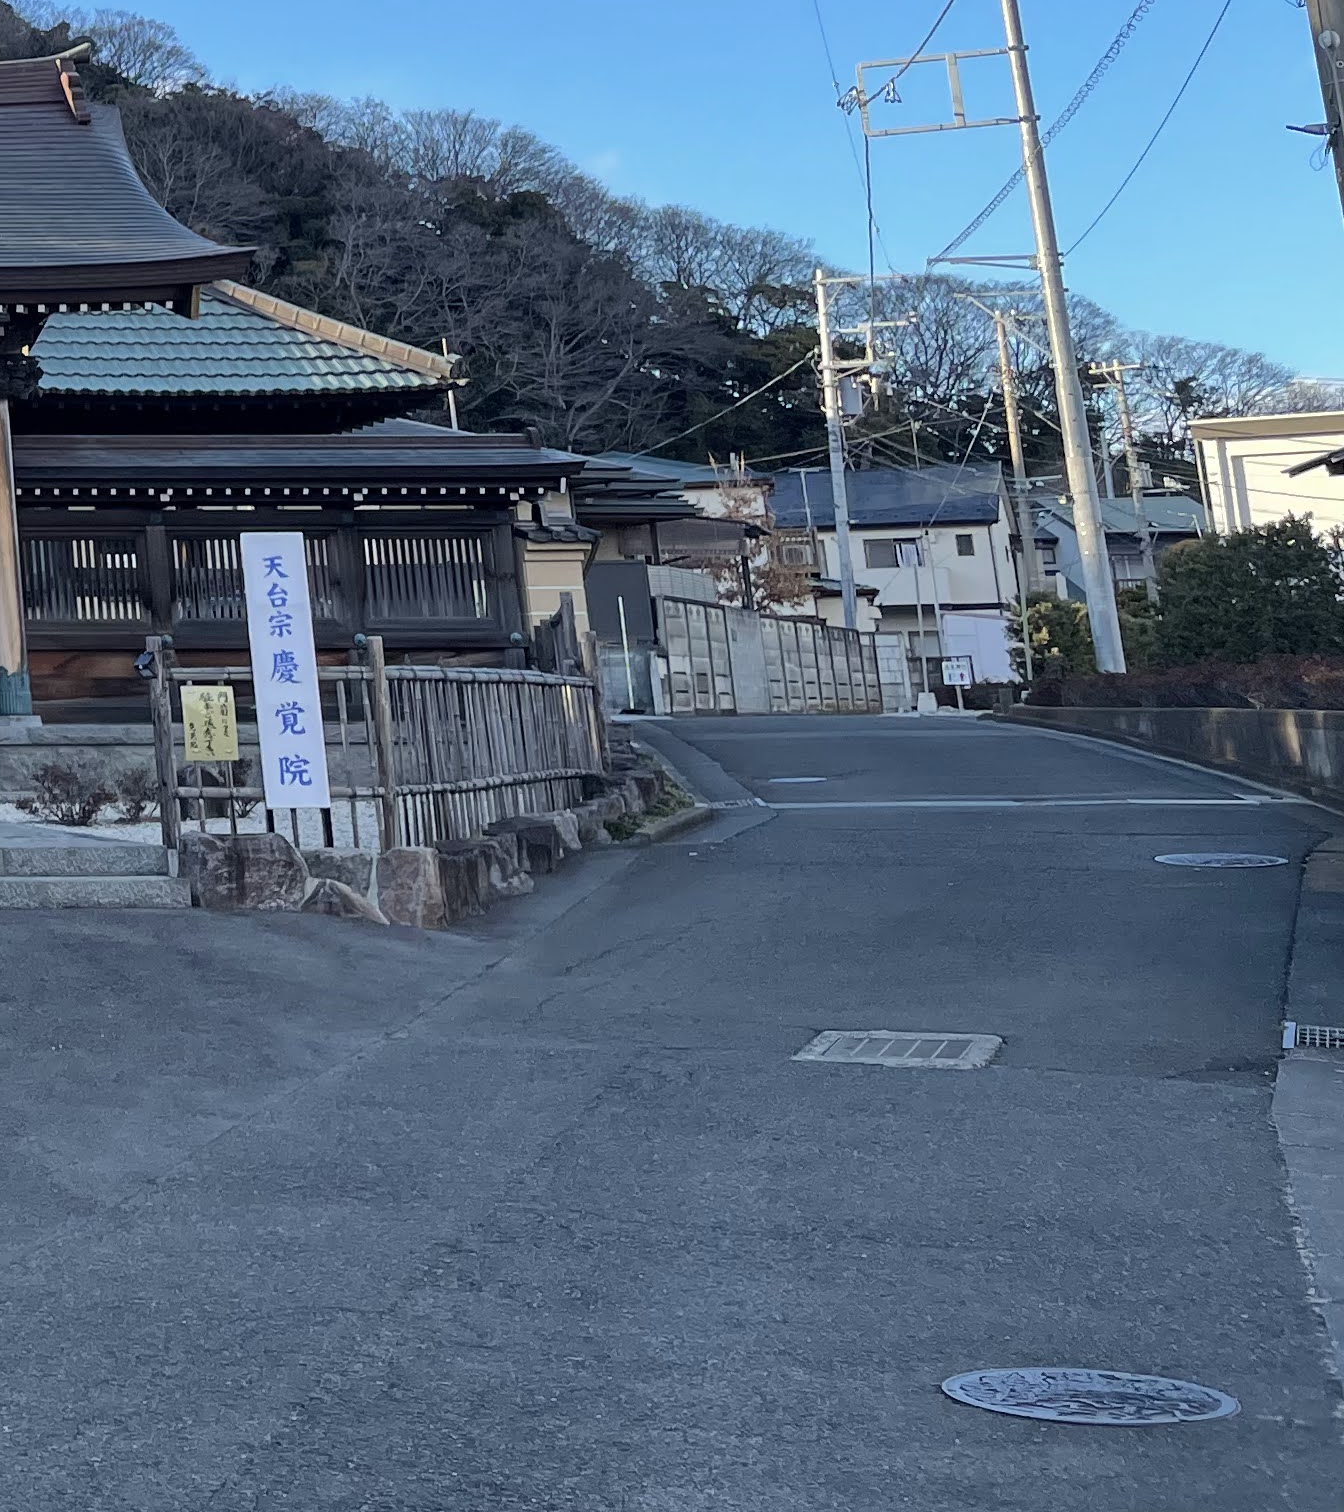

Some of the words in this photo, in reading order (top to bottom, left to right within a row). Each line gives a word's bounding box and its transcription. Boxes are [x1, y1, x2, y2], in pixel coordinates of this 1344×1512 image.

[262, 554, 313, 787] 天台宗慶覚院
